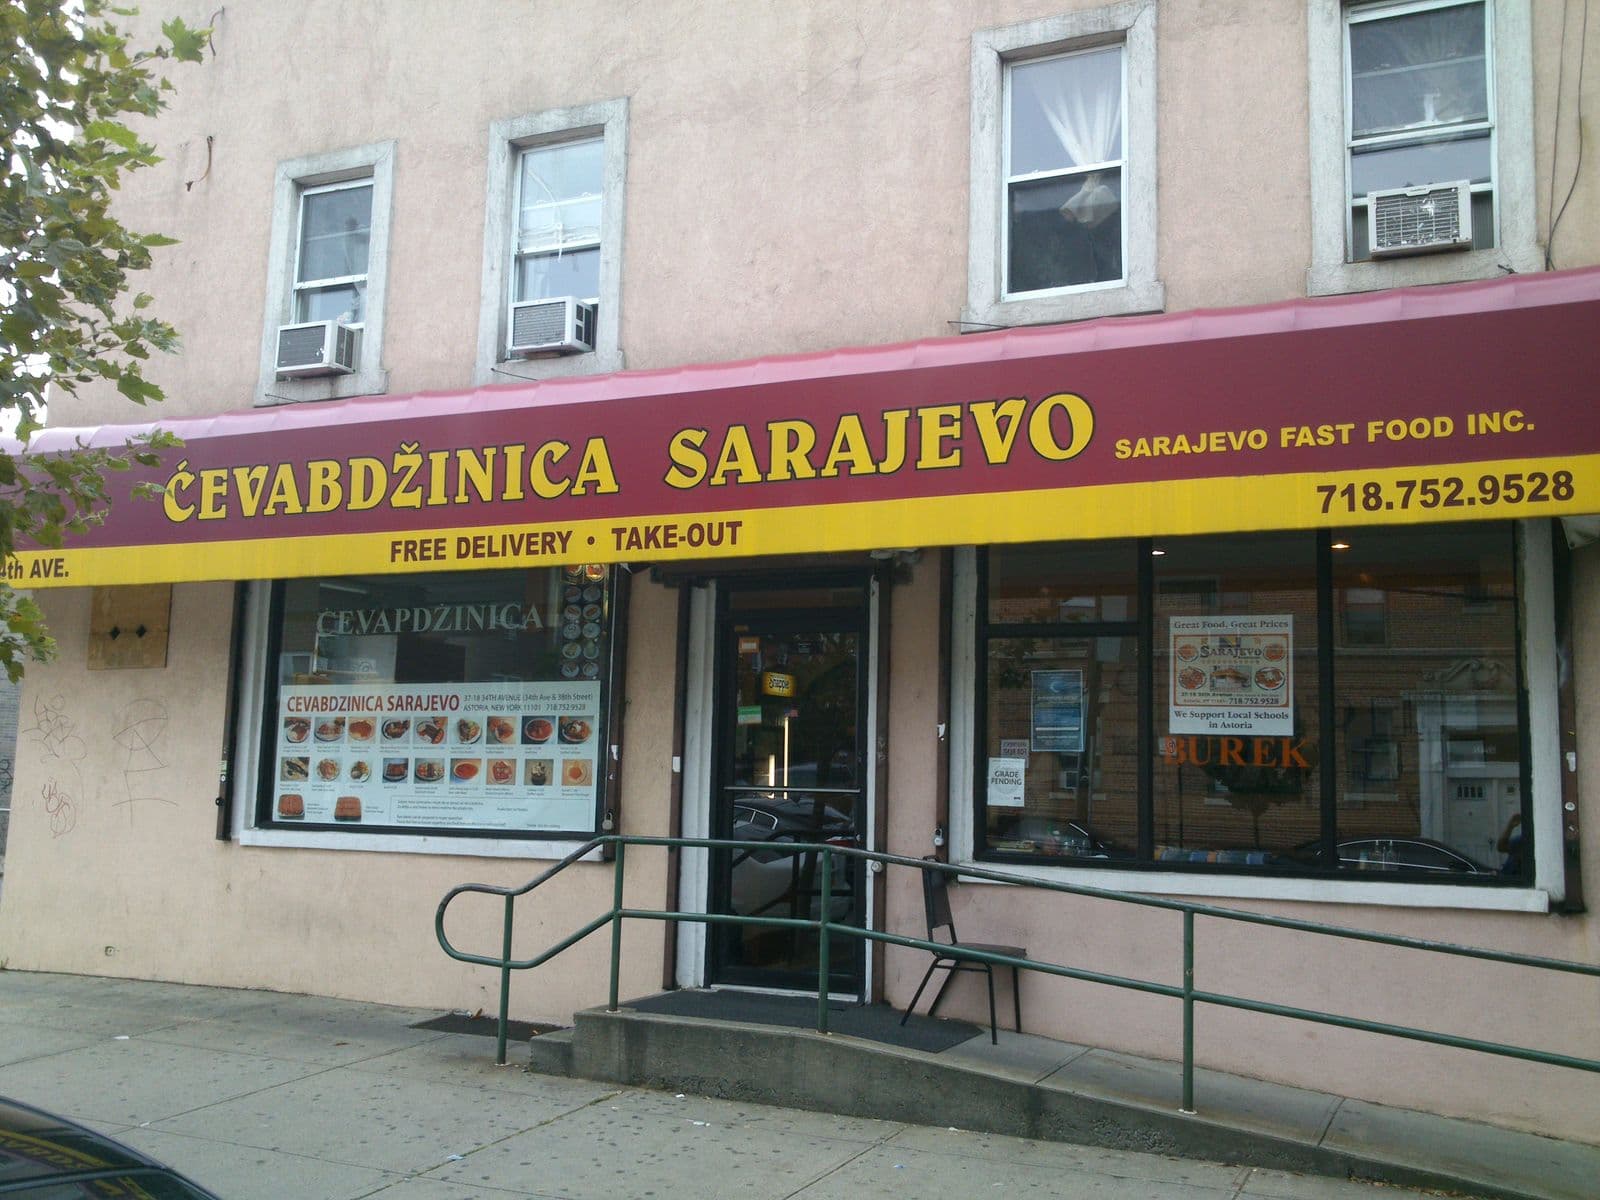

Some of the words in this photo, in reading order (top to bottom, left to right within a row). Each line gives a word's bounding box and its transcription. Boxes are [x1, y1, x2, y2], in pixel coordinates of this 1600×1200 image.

[1114, 428, 1268, 460] SARAJEVO
[1280, 422, 1355, 448] FAST
[1367, 416, 1454, 442] FOOD
[1467, 409, 1535, 435] INC.
[163, 436, 620, 523] ĆEVABDŽINICA
[663, 391, 1096, 489] SARAJEVO
[1316, 470, 1575, 514] 718.752.9528
[390, 538, 447, 563] FREE
[456, 530, 573, 560] DELIVERY
[611, 521, 743, 551] TAKE-OUT
[30, 558, 70, 578] AVE.
[1174, 621, 1200, 629] Great
[1231, 620, 1257, 628] Great
[1260, 620, 1288, 628] Prices
[287, 695, 384, 713] CEVABDZINICA
[387, 694, 460, 712] SARAJEVO
[491, 704, 506, 712] NEW
[1174, 710, 1188, 719] We
[1190, 710, 1225, 721] Support
[1228, 711, 1251, 719] Local
[1254, 711, 1289, 720] Schools
[1208, 720, 1218, 729] in
[1220, 721, 1253, 729] Astoria
[1164, 736, 1311, 769] BUREK
[990, 777, 1022, 786] PENDING
[994, 770, 1020, 779] GRADE
